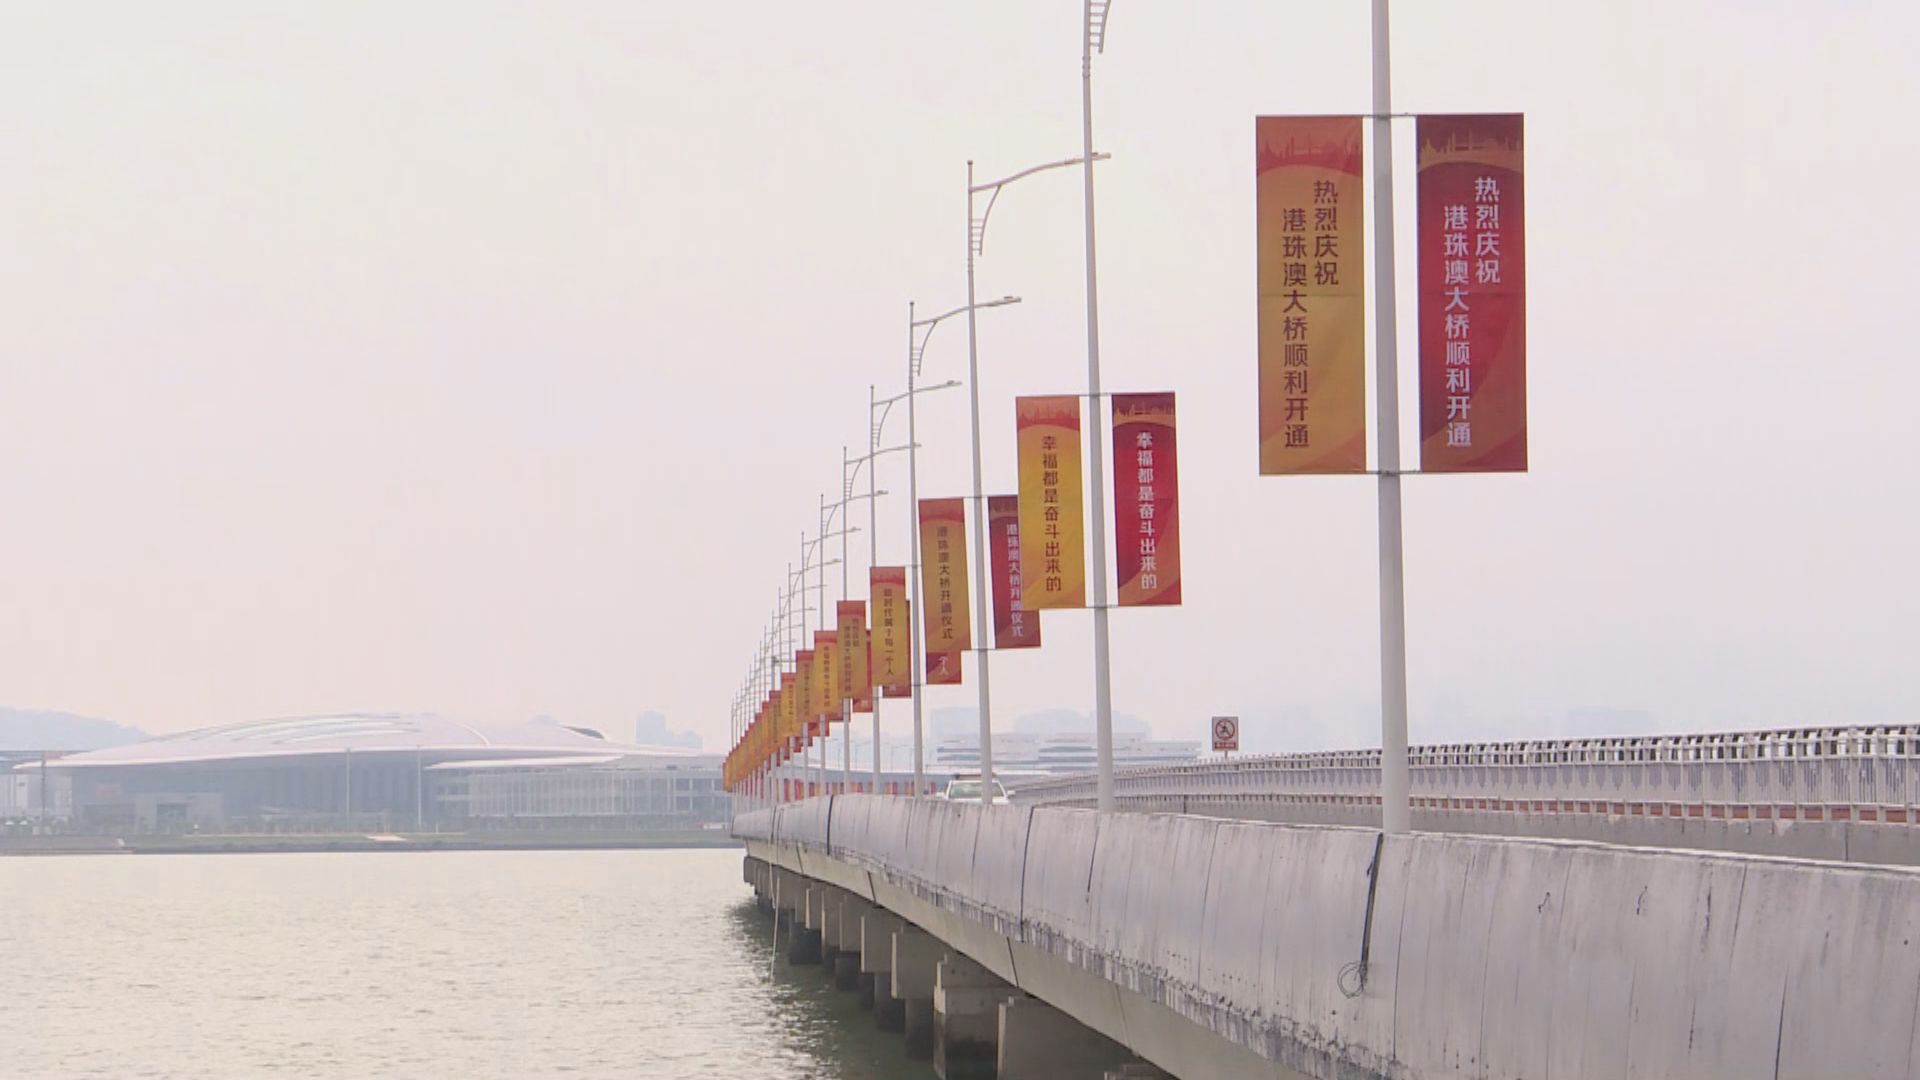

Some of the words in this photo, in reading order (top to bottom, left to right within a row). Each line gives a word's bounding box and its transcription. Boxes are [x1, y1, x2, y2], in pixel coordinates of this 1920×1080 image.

[1314, 180, 1338, 285] 热烈庆祝
[1475, 176, 1501, 283] 热烈庆祝
[1283, 208, 1309, 448] 港珠澳大桥顺利开通
[1444, 206, 1471, 448] 港珠澳大桥顺利开通
[1042, 435, 1062, 592] 幸福都是奋斗出来的
[1136, 431, 1157, 590] 幸福都是奋斗出来的
